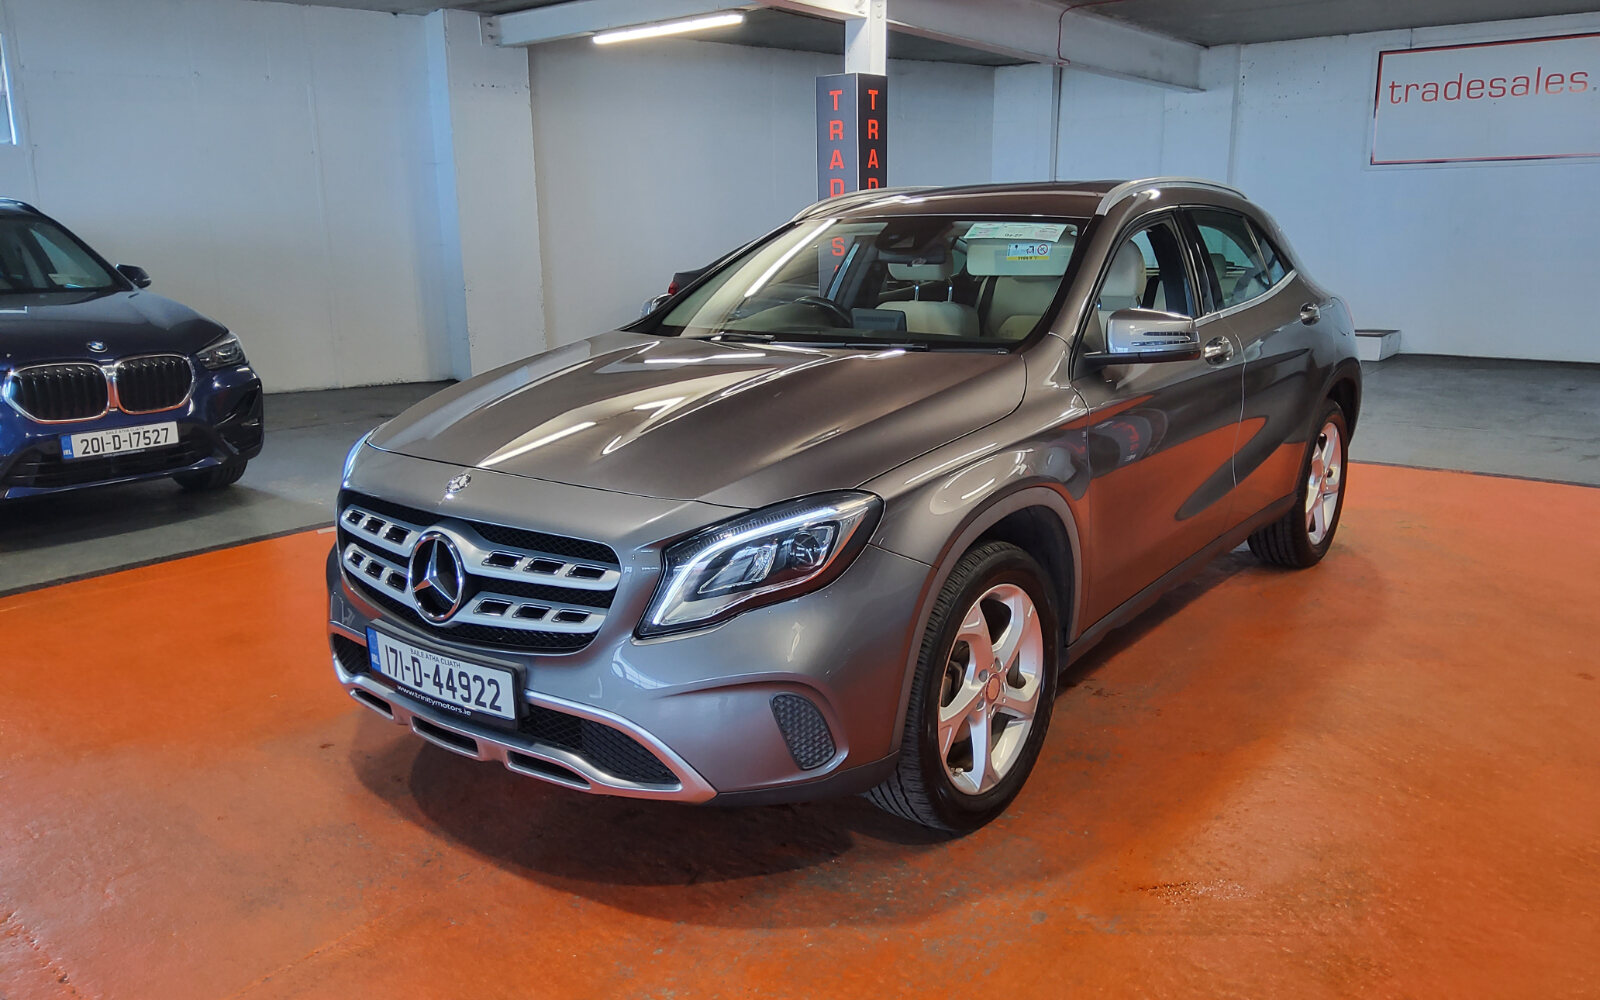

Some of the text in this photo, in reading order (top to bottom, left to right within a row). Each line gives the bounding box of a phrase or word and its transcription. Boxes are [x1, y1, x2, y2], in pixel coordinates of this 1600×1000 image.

[80, 427, 169, 455] 201-D-17527
[384, 644, 503, 713] 171-D-44922
[397, 685, 472, 716] www.trinitymotors.ie
